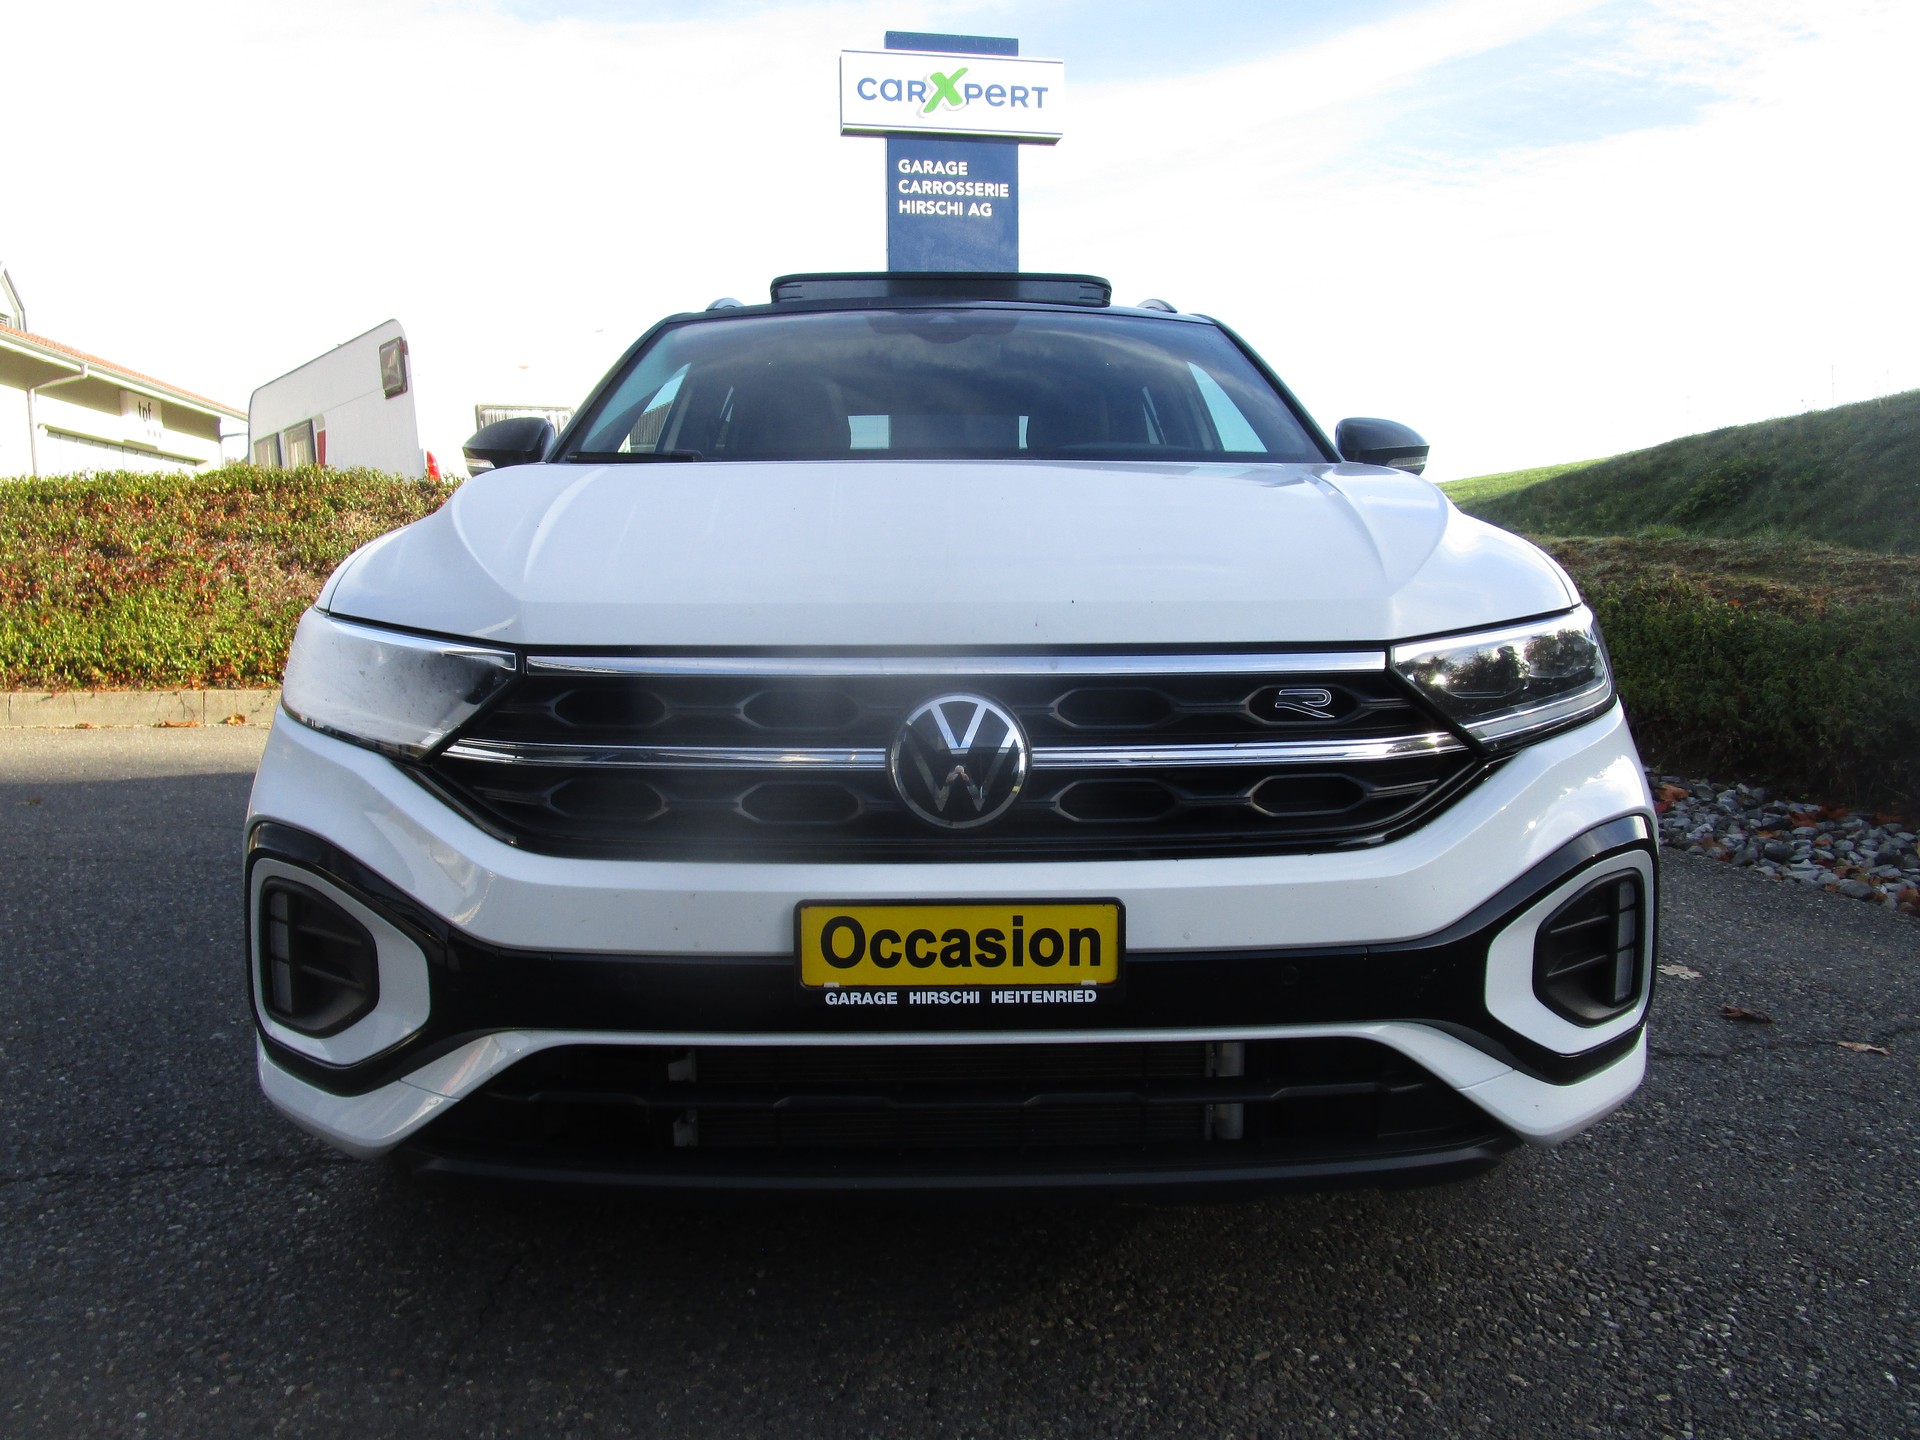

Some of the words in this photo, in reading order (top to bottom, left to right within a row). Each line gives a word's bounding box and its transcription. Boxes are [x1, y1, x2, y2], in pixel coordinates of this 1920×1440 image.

[898, 159, 968, 176] GARAGE
[898, 179, 1009, 197] CARROSSERIE
[898, 200, 964, 216] HIRSCHI
[968, 202, 993, 217] AG
[820, 915, 1101, 969] Occasion
[825, 992, 898, 1005] GARAGE
[909, 991, 980, 1005] HIRSCHI
[991, 990, 1097, 1003] HEITENRIED
